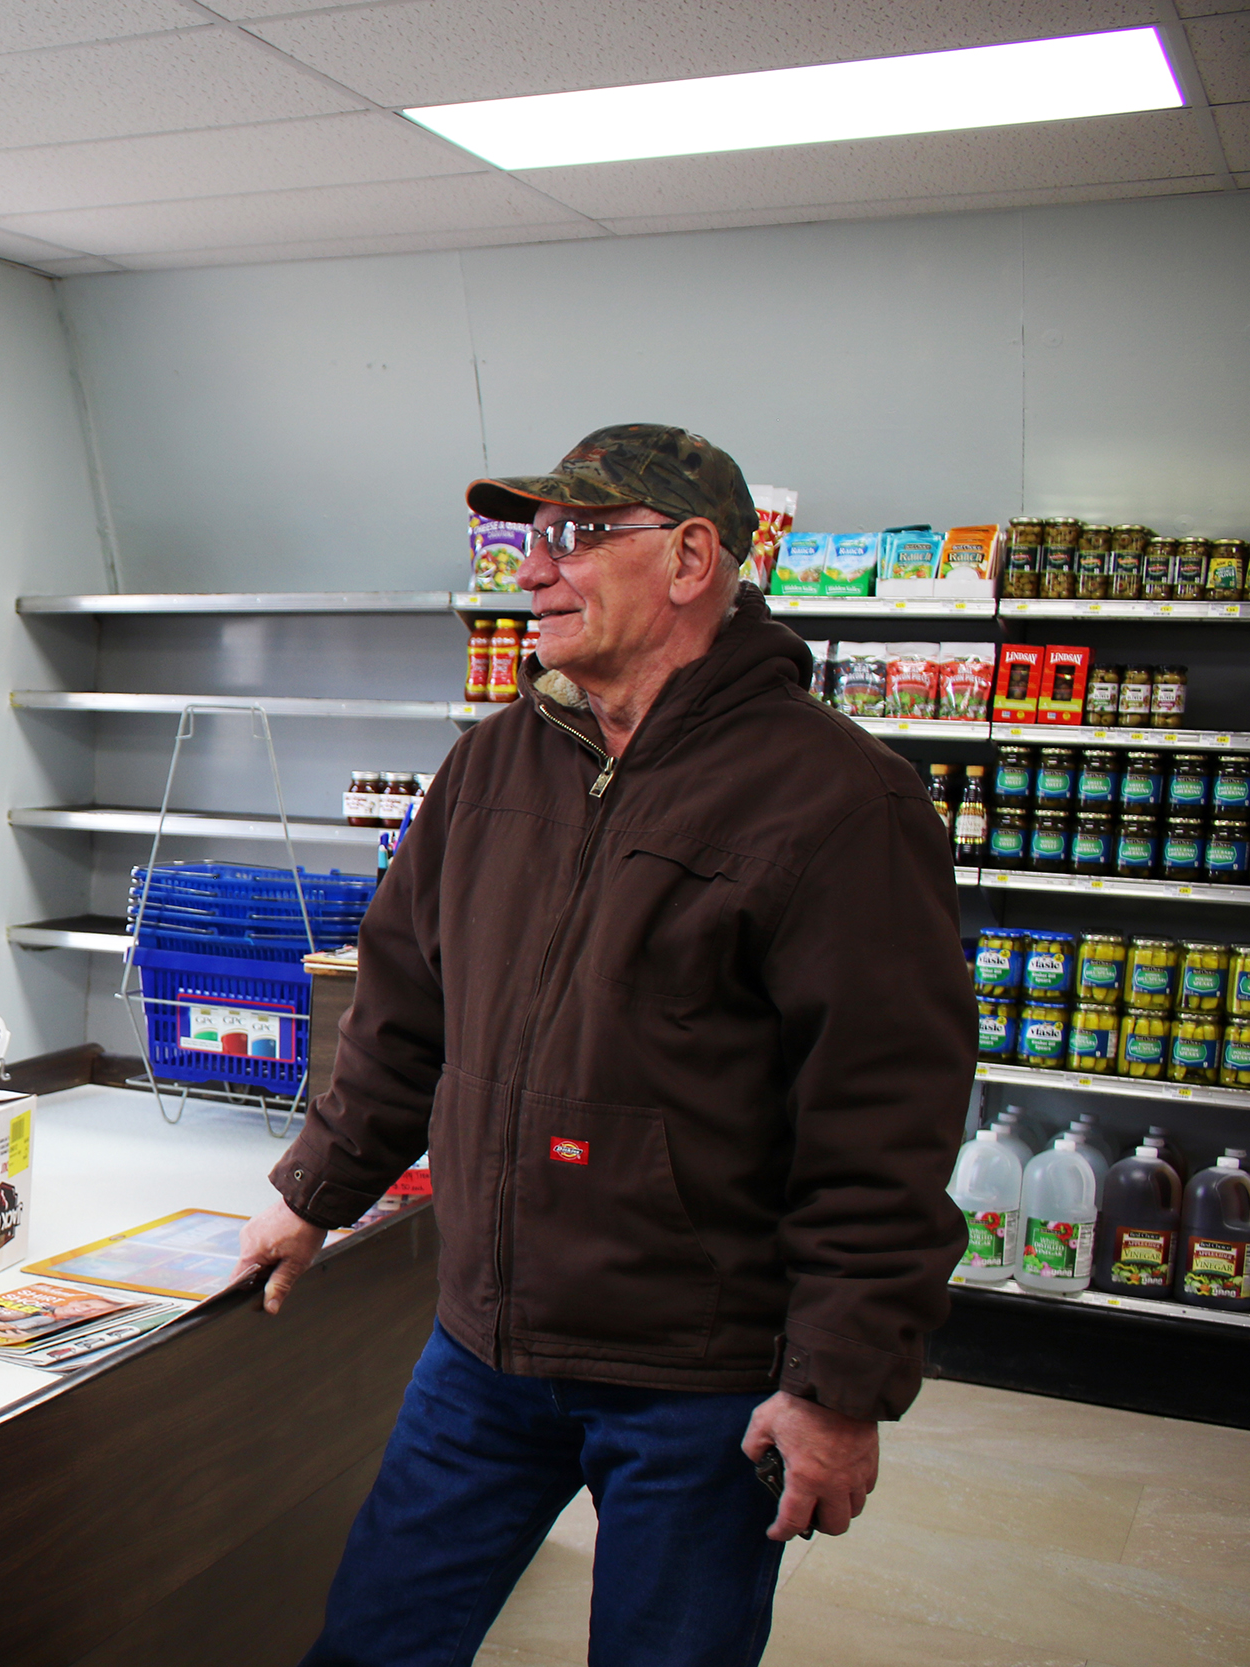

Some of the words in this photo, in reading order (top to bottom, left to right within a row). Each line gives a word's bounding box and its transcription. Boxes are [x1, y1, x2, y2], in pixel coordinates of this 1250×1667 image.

[899, 552, 932, 562] Ranch
[949, 551, 982, 562] Ranch
[1030, 960, 1061, 970] vlasic
[193, 1015, 218, 1026] GPC
[221, 1015, 247, 1027] GPC
[251, 1022, 276, 1033] GPC
[1030, 1027, 1060, 1039] vlasic
[1123, 1248, 1161, 1261] VINEGAR
[1194, 1258, 1233, 1272] VINEGAR
